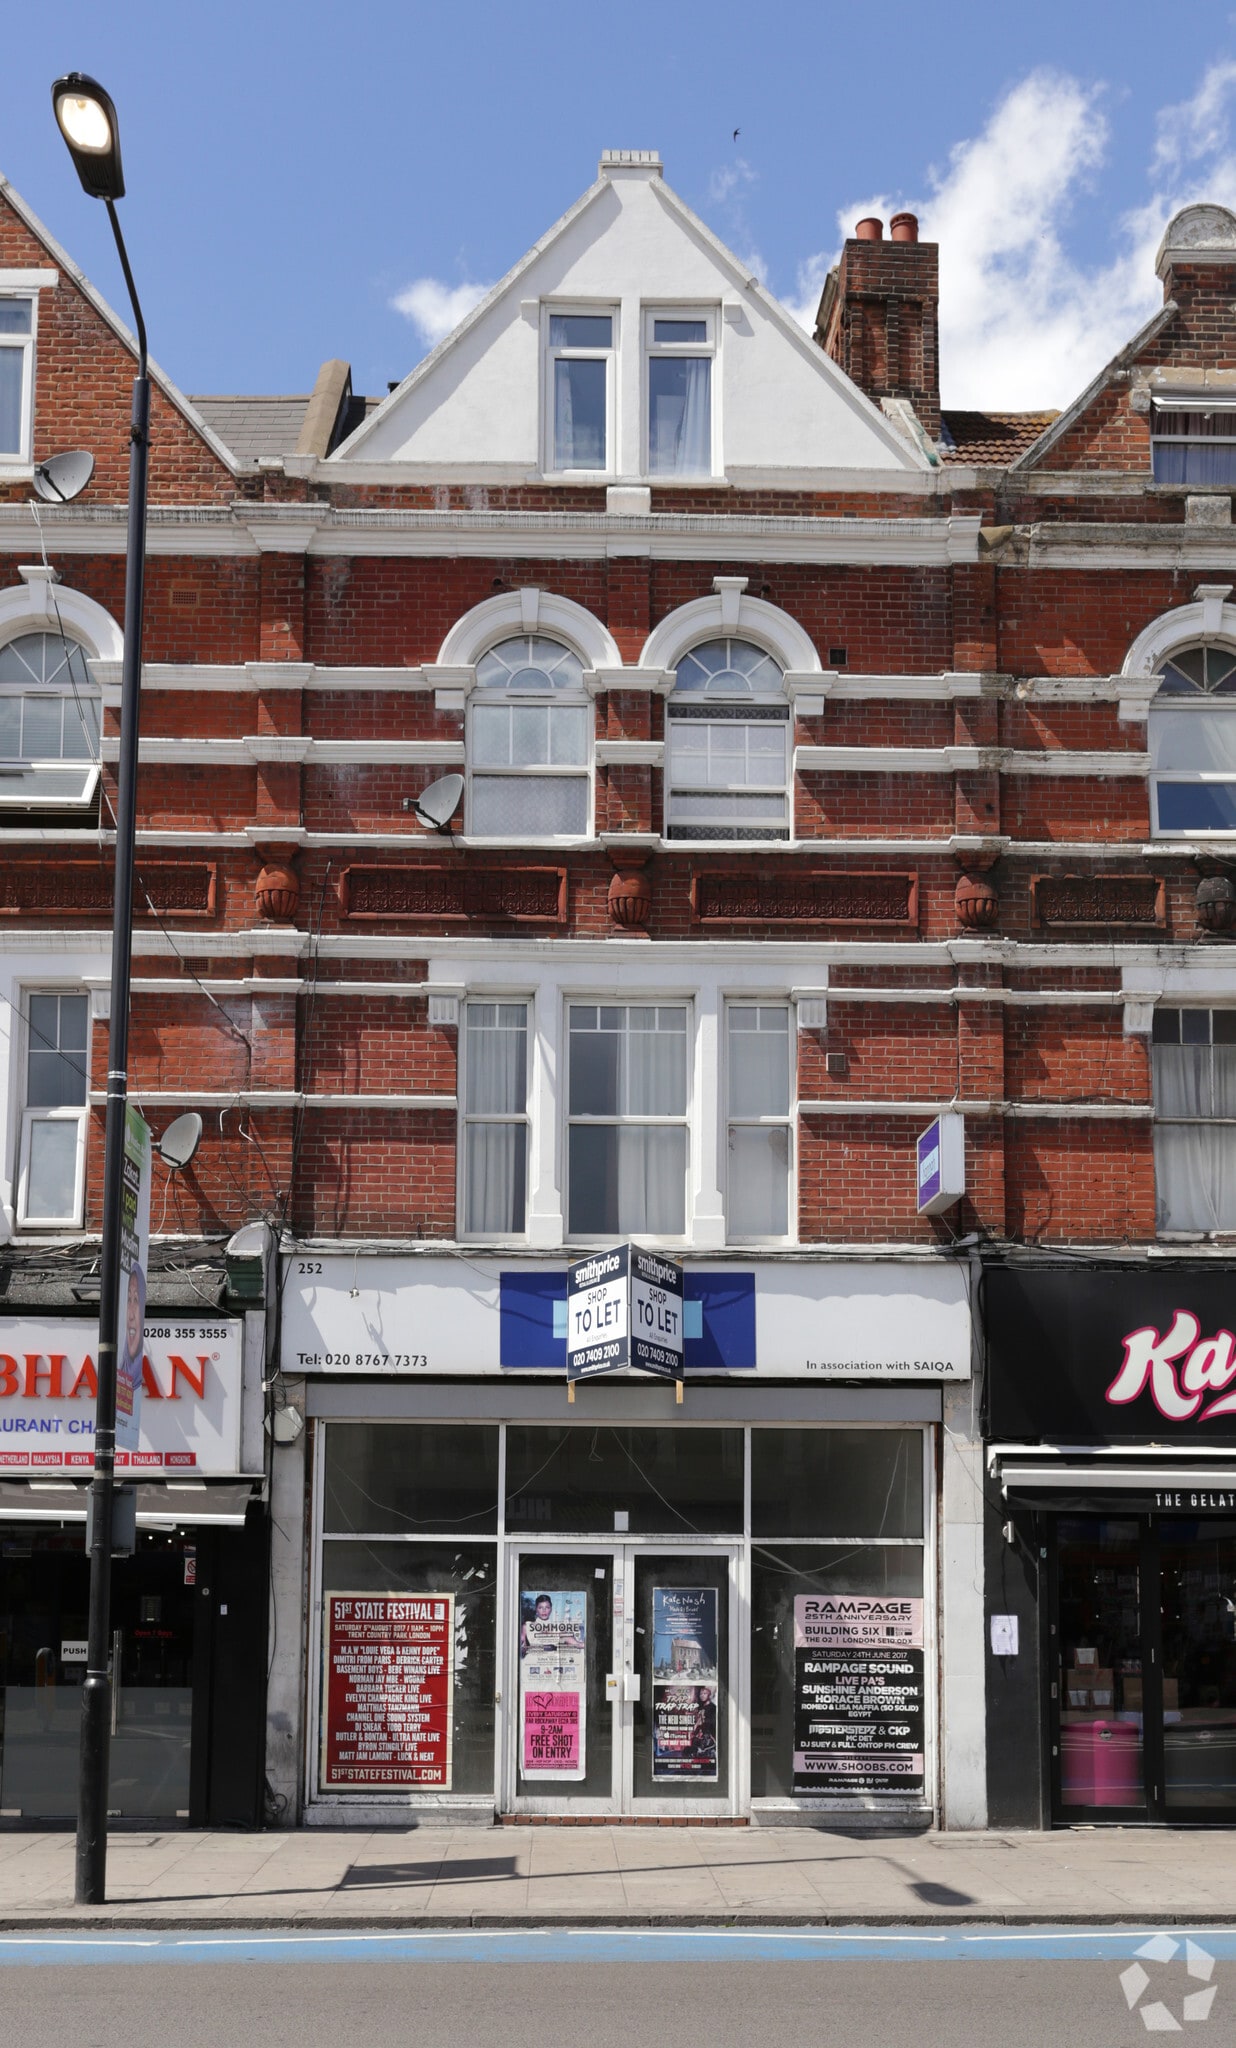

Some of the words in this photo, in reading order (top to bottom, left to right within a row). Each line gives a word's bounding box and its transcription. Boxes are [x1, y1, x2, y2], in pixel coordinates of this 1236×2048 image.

[298, 1262, 322, 1274] 252
[575, 1254, 620, 1284] smithprice
[638, 1256, 676, 1284] smithprice
[588, 1288, 607, 1304] SHOP
[649, 1288, 666, 1304] SHOP
[576, 1308, 592, 1334] TO
[596, 1298, 621, 1328] LET
[638, 1299, 654, 1326] TO
[658, 1306, 678, 1335] LET
[143, 1328, 170, 1338] 0208
[174, 1328, 196, 1338] 355
[199, 1328, 227, 1338] 3555
[296, 1353, 322, 1364] Tel:
[325, 1354, 350, 1366] 020
[355, 1354, 390, 1366] 8767
[394, 1355, 428, 1366] 7373
[573, 1352, 586, 1366] 020
[586, 1347, 602, 1363] 7409
[604, 1343, 620, 1358] 2100
[637, 1343, 649, 1358] 020
[650, 1347, 664, 1362] 7409
[666, 1352, 678, 1366] 2100
[806, 1360, 817, 1370] In
[820, 1360, 882, 1370] association
[886, 1361, 910, 1370] with
[914, 1362, 954, 1372] SAIQA
[0, 1354, 209, 1400] BHAAN
[33, 1454, 60, 1464] MALAYSIA
[71, 1455, 90, 1464] KENYA
[134, 1456, 160, 1464] THAILAND
[1155, 1494, 1182, 1506] THE
[1190, 1494, 1234, 1506] GELAT
[663, 1594, 680, 1607] Kate
[682, 1592, 706, 1605] Nash
[334, 1602, 352, 1620] 51ST
[354, 1602, 384, 1620] STATE
[386, 1602, 433, 1620] FESTIVAL
[805, 1602, 912, 1614] RAMPAGE
[370, 1624, 392, 1632] AUGUST
[529, 1623, 579, 1632] SOMMORE
[805, 1626, 858, 1635] BUILDING
[862, 1627, 880, 1635] SIX
[380, 1646, 395, 1654] VEGA
[402, 1646, 421, 1654] KENNY
[812, 1650, 852, 1658] SATURDAY
[333, 1655, 356, 1664] DIMITRI
[357, 1656, 373, 1664] FROM
[374, 1656, 392, 1664] PARIS
[396, 1656, 421, 1665] DERRICK
[421, 1656, 444, 1665] CARTER
[336, 1665, 367, 1674] BASEMENT
[368, 1665, 384, 1674] BOYS
[404, 1666, 427, 1674] WINANS
[428, 1666, 440, 1674] LIVE
[804, 1662, 867, 1673] RAMPAGE
[868, 1664, 914, 1674] SOUND
[348, 1674, 375, 1683] NORMAN
[375, 1675, 384, 1683] JAY
[835, 1676, 859, 1685] LIVE
[408, 1685, 420, 1693] LIVE
[802, 1684, 856, 1694] SUNSHINE
[858, 1686, 918, 1696] ANDERSON
[346, 1694, 366, 1702] EVELYN
[367, 1694, 403, 1703] CHAMPAGNE
[404, 1694, 418, 1703] KING
[420, 1694, 432, 1703] LIVE
[815, 1695, 860, 1704] HORACE
[862, 1696, 905, 1704] BROWN
[358, 1703, 387, 1712] MATTHIAS
[346, 1713, 373, 1722] CHANNEL
[387, 1713, 406, 1722] SOUND
[407, 1714, 430, 1722] SYSTEM
[363, 1723, 382, 1731] SNEAK
[403, 1723, 421, 1732] TERRY
[541, 1725, 563, 1734] 9-2AM
[888, 1726, 911, 1735] CKP
[336, 1732, 357, 1740] BUTLER
[392, 1732, 411, 1741] ULTRA
[428, 1733, 440, 1742] LIVE
[530, 1735, 550, 1746] FREE
[553, 1735, 573, 1746] SHOT
[358, 1742, 377, 1751] BYRON
[405, 1743, 417, 1751] LIVE
[339, 1752, 355, 1760] MATT
[356, 1752, 368, 1760] JAM
[369, 1752, 392, 1760] LAMONT
[397, 1752, 412, 1761] LUCK
[419, 1752, 435, 1761] NEAT
[533, 1747, 543, 1758] ON
[546, 1747, 572, 1758] ENTRY
[804, 1762, 913, 1772] WWW.SHOOBS.COM
